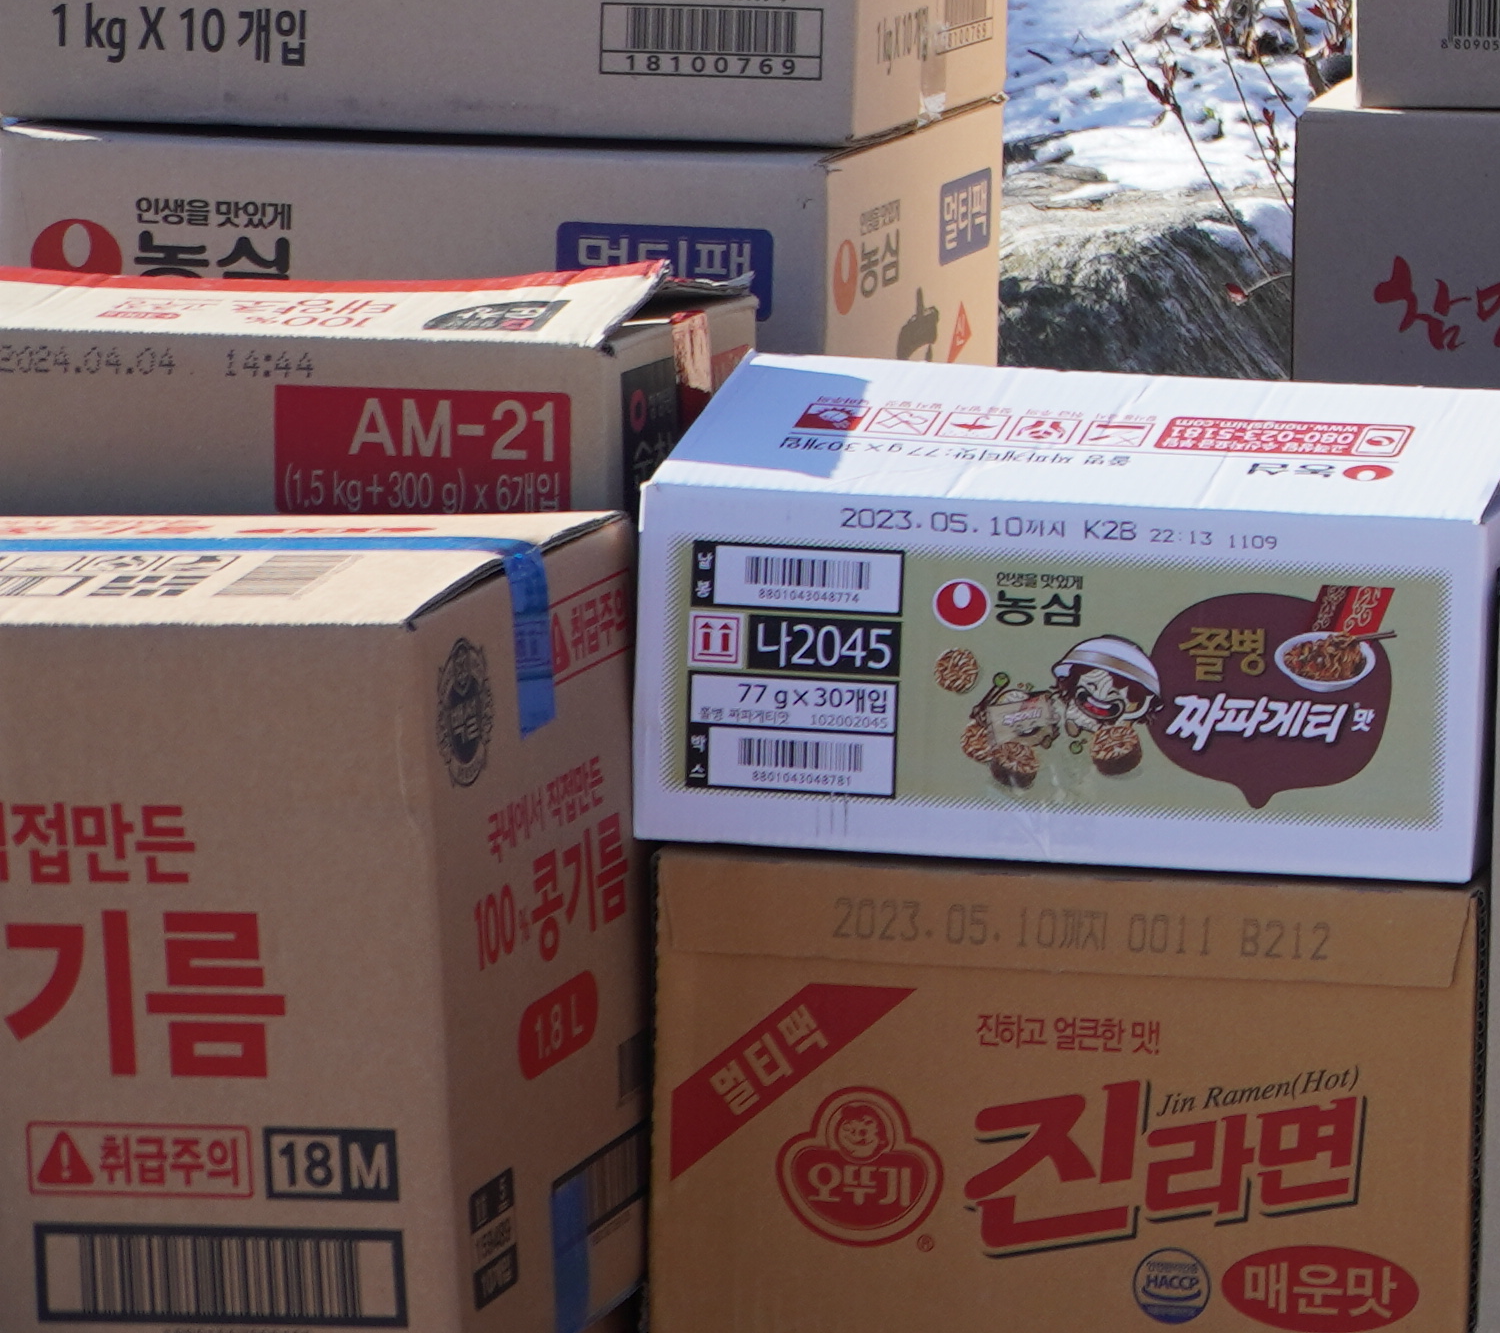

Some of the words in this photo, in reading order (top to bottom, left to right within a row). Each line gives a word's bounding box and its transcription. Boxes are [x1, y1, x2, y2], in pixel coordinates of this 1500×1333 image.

[85, 2, 127, 63] kg
[180, 8, 225, 52] 10
[237, 9, 307, 66] 개입
[626, 54, 796, 75] 18100769
[135, 197, 210, 226] 인생을
[215, 200, 292, 230] 맛있게
[944, 180, 987, 250] 멀티팩
[860, 229, 899, 298] 농심
[225, 349, 314, 378] 14:44
[349, 398, 555, 463] AM-21
[1172, 427, 1354, 443] 080-023-5181
[1176, 419, 1359, 432] www.nongshim.com
[1248, 463, 1335, 478] 농심
[1150, 528, 1212, 546] 22:13
[1228, 533, 1277, 551] 1109
[997, 572, 1038, 589] 인생을
[1041, 573, 1083, 590] 맛있게
[996, 591, 1082, 628] 농심
[756, 621, 892, 669] 나2045
[1179, 626, 1266, 683] 쫄병
[1166, 693, 1348, 751] 짜파게티
[532, 813, 628, 962] 콩기름
[4, 909, 286, 1079] 기름
[976, 1013, 1047, 1049] 진하고
[1053, 1017, 1125, 1054] 얼큰한
[709, 1004, 828, 1116] 멀티팩
[1156, 1092, 1196, 1117] Jin
[1202, 1065, 1360, 1110] Ramen(Hot)
[100, 1136, 239, 1188] 취급주의
[808, 1162, 911, 1207] 오뚜기
[963, 1080, 1366, 1255] 진라면
[1146, 1274, 1199, 1290] HACCP
[1244, 1261, 1397, 1319] 매운맛
